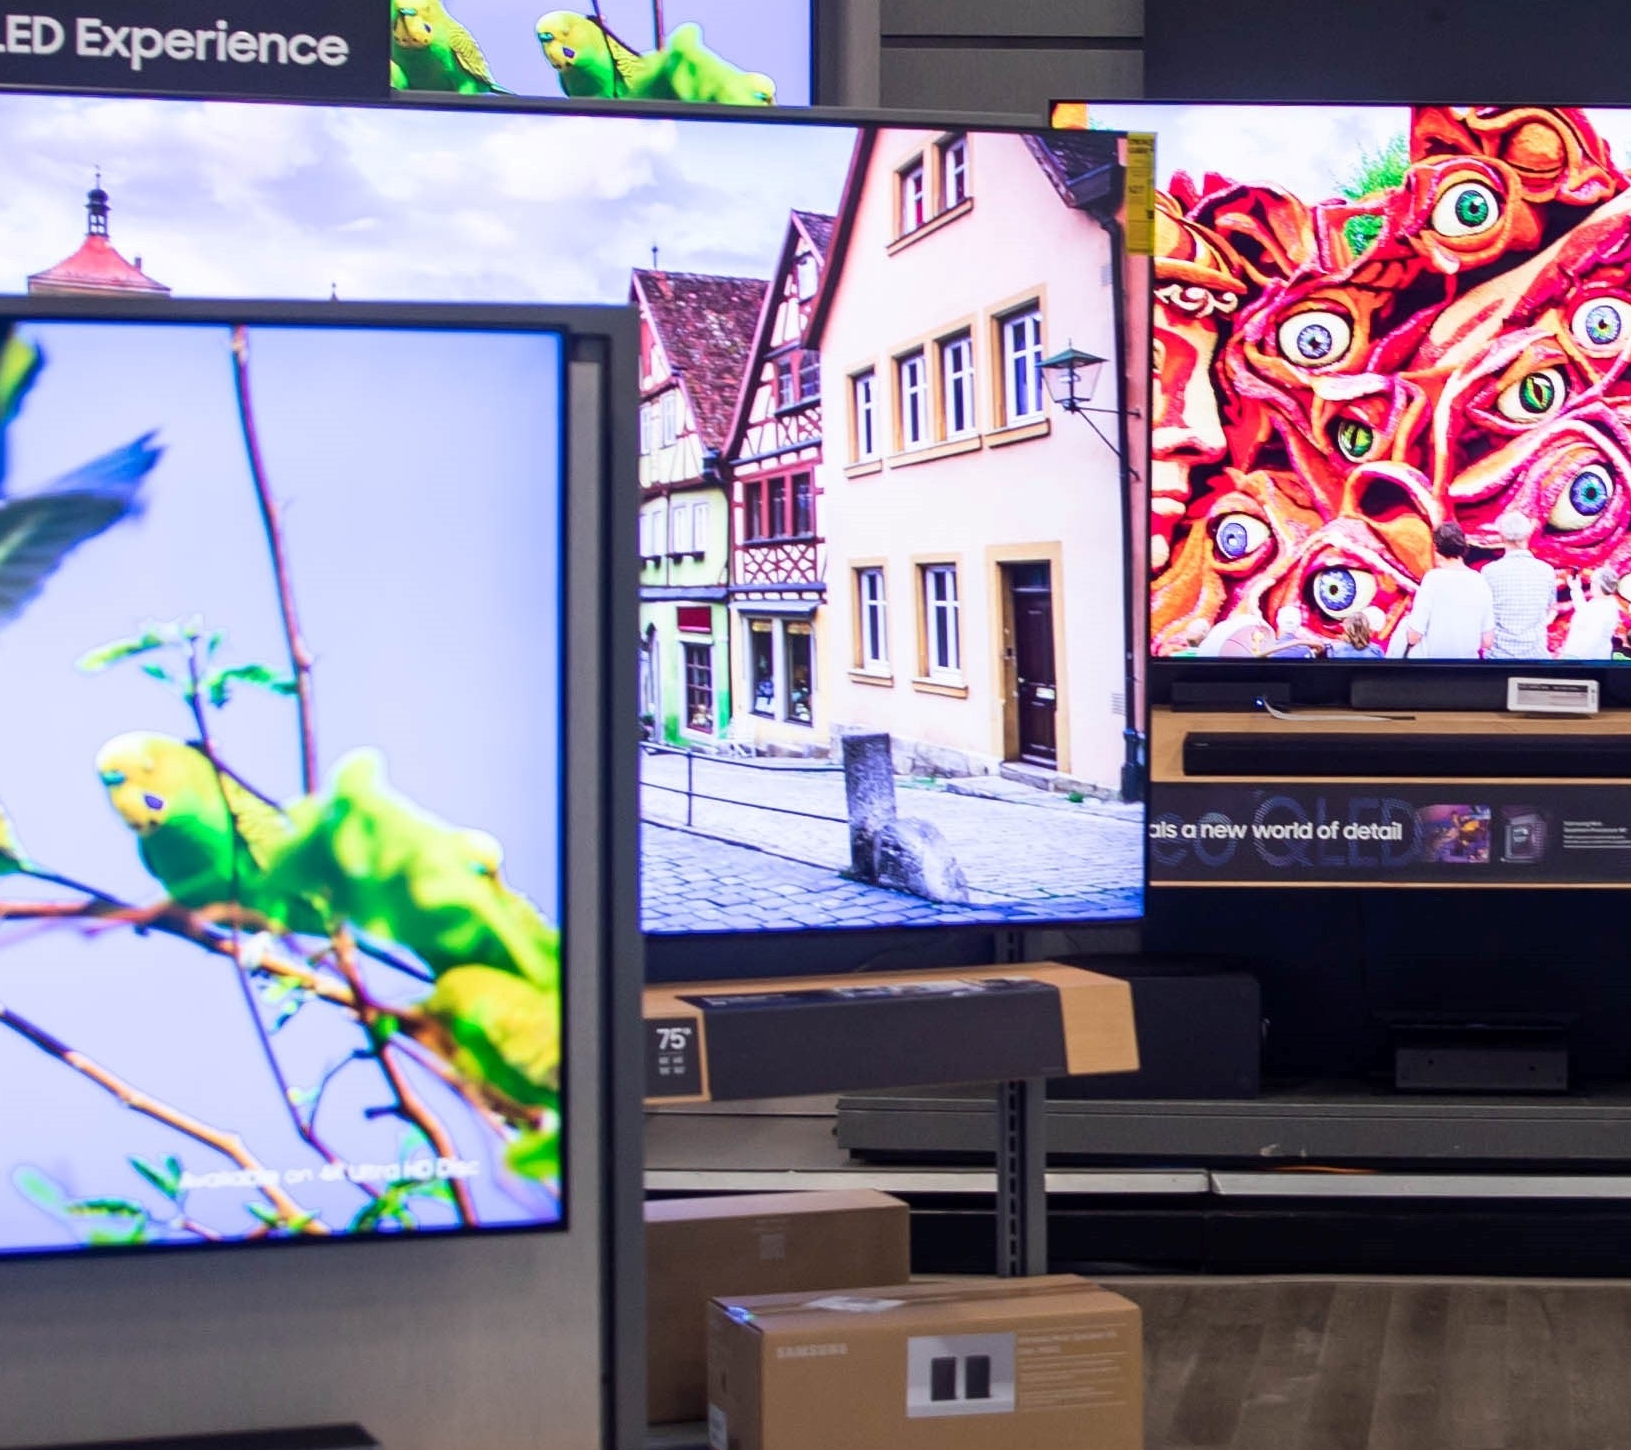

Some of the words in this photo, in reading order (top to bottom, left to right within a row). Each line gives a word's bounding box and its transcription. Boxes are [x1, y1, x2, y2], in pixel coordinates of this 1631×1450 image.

[76, 16, 350, 70] Experience
[1181, 824, 1196, 839] a
[1200, 824, 1247, 839] new
[1251, 821, 1313, 840] world
[1316, 821, 1340, 840] of
[1342, 821, 1402, 841] detail
